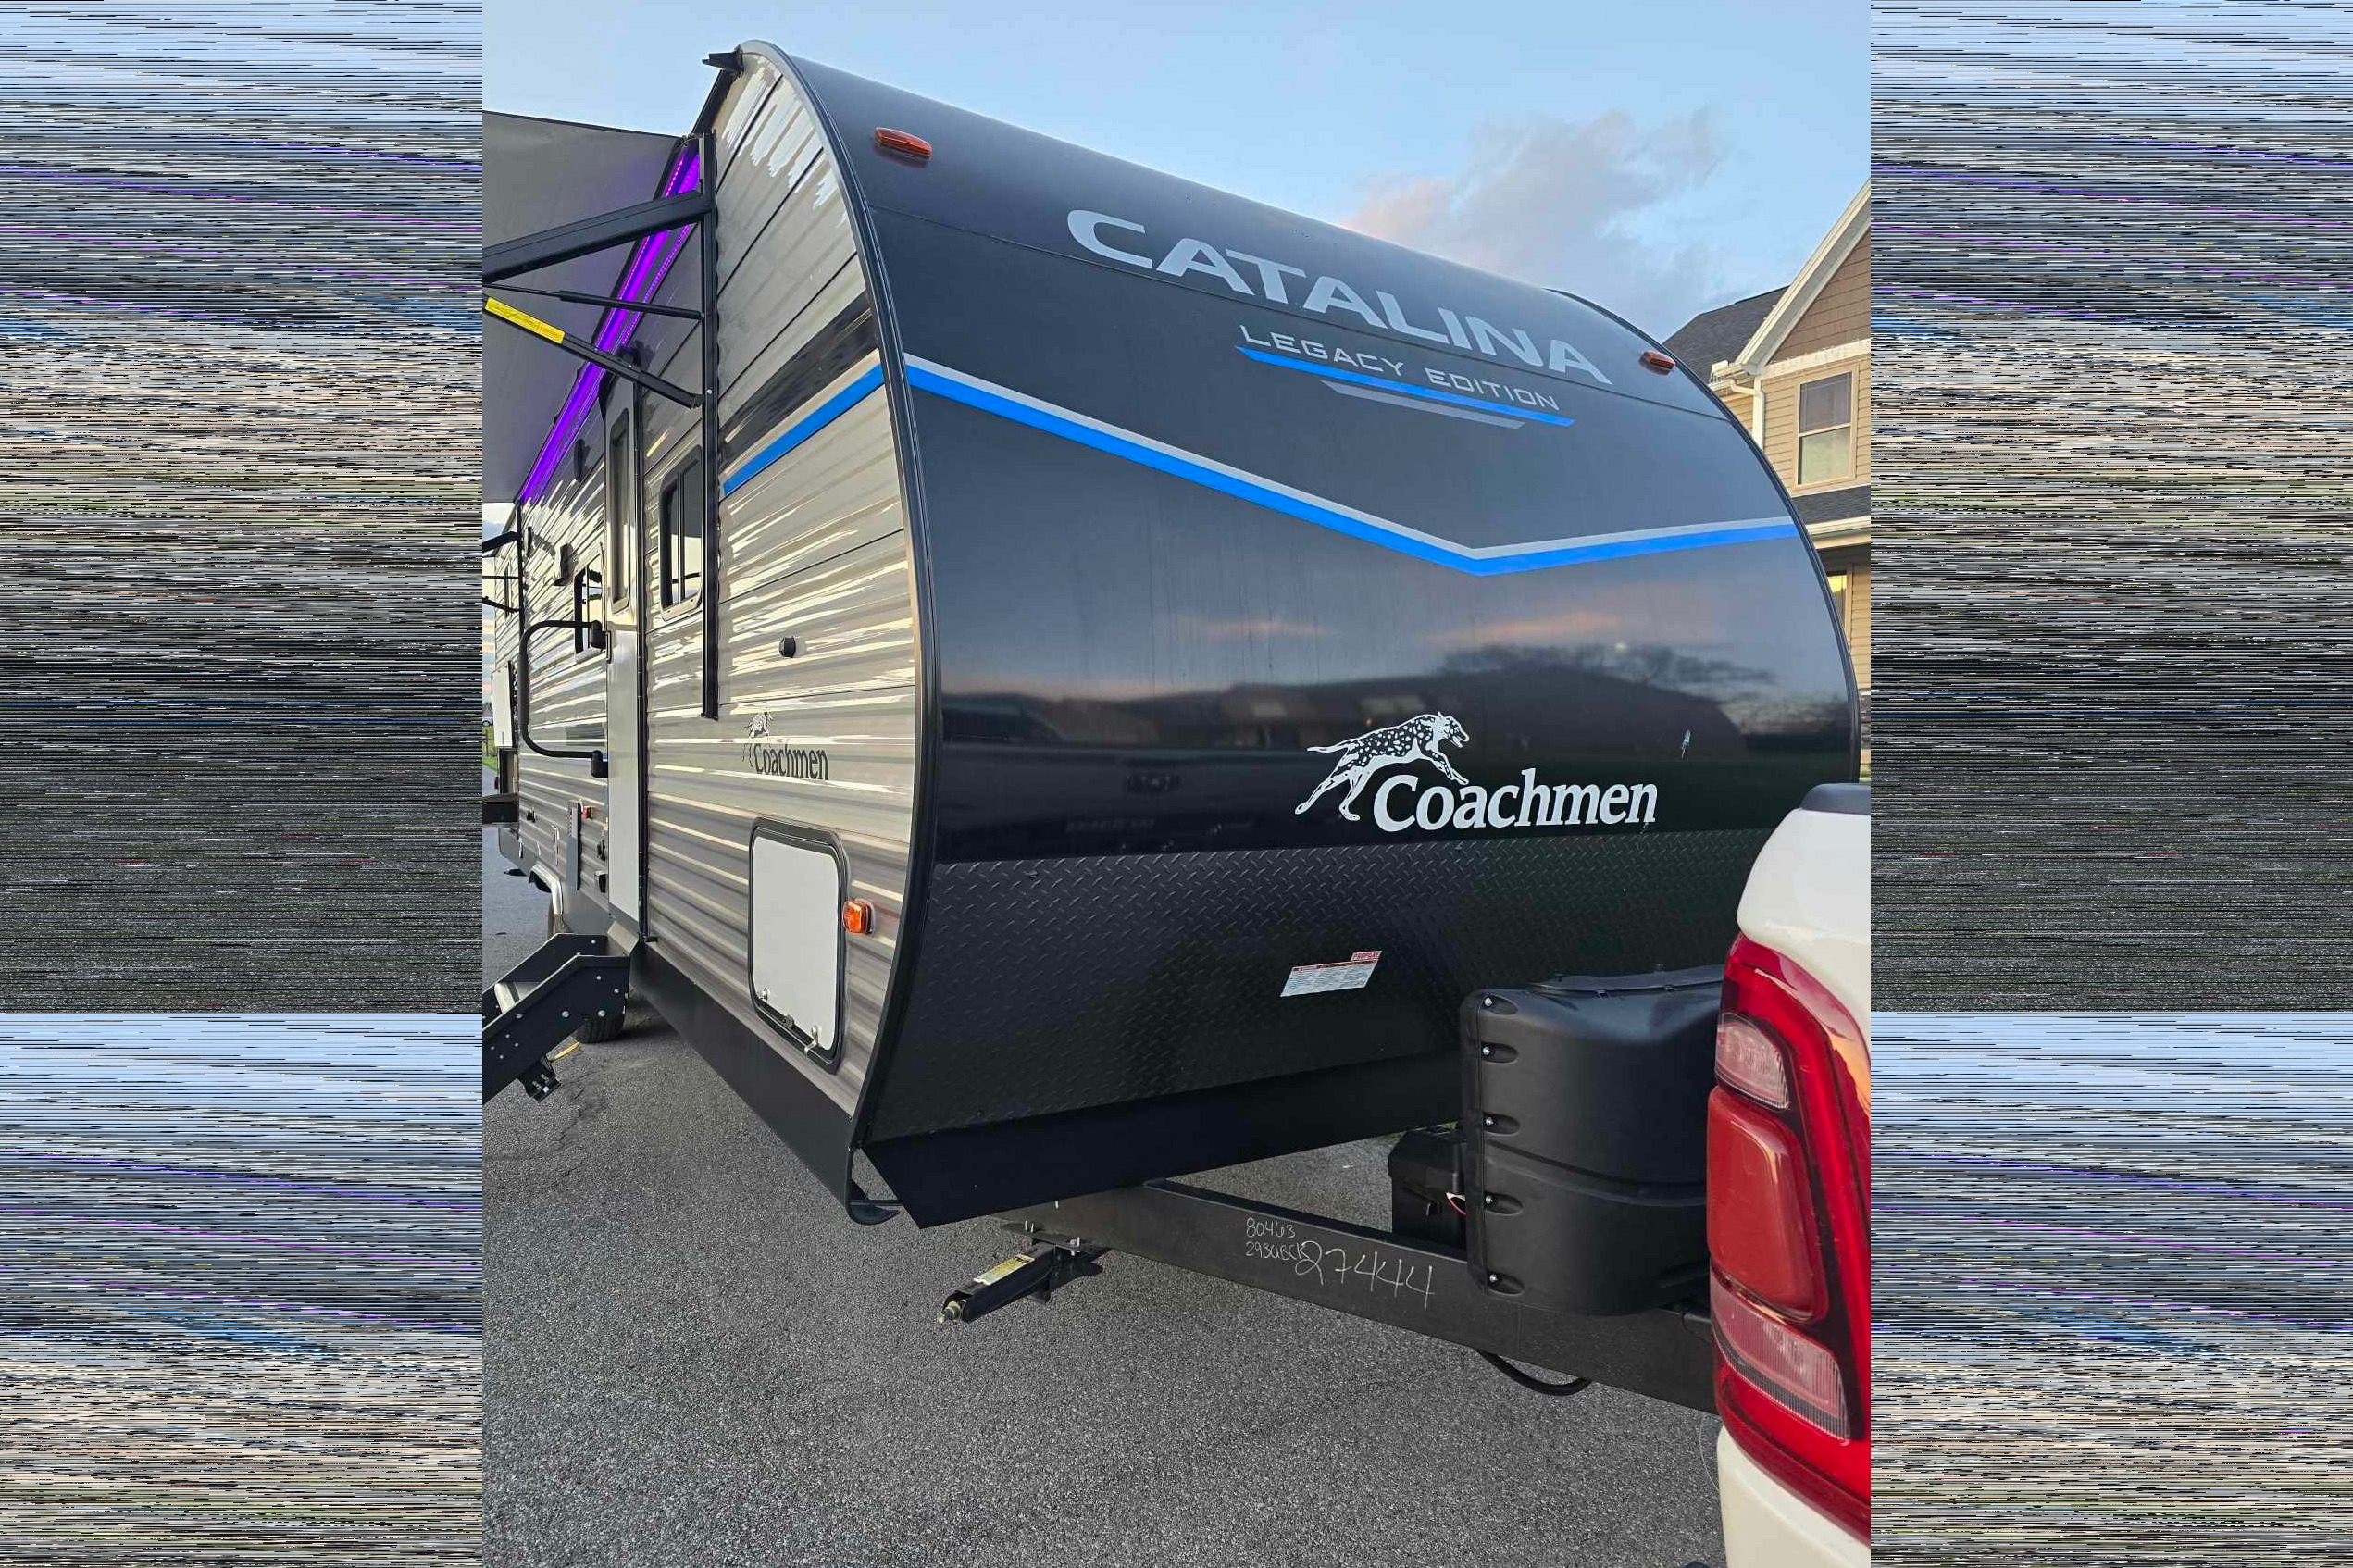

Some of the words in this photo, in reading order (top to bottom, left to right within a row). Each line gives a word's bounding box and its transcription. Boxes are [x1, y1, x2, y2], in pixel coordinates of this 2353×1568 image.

[1067, 209, 1612, 385] CATALINA
[1239, 325, 1405, 377] LEGACY
[1424, 367, 1560, 411] EDITION
[753, 742, 828, 780] Coachmen
[1373, 767, 1658, 832] Coachmen
[1246, 1217, 1296, 1239] 80463
